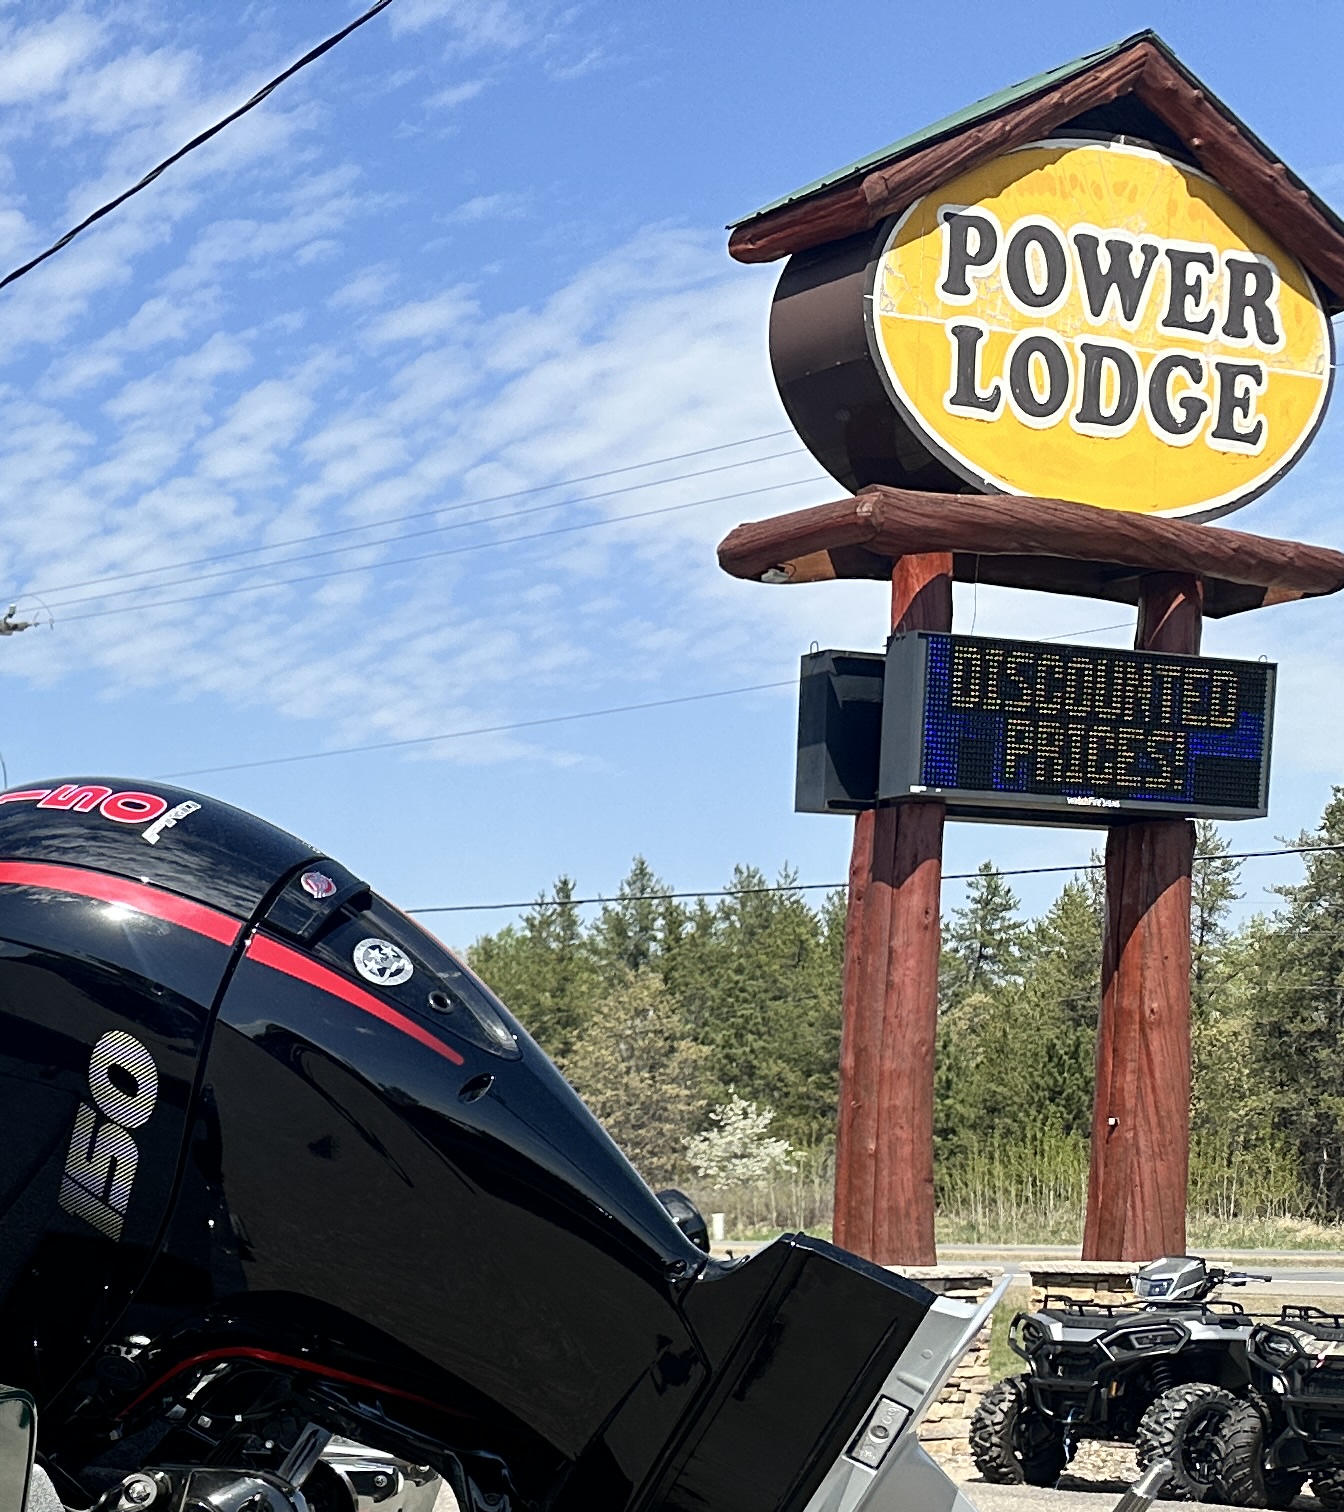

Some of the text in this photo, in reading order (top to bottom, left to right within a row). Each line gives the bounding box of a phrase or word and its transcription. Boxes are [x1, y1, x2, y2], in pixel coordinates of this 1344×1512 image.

[941, 211, 1280, 345] POWER
[949, 324, 1263, 446] LODGE
[952, 645, 1239, 729] DISCOUNTED
[1005, 718, 1188, 791] PRICES!
[57, 1029, 159, 1243] 150
